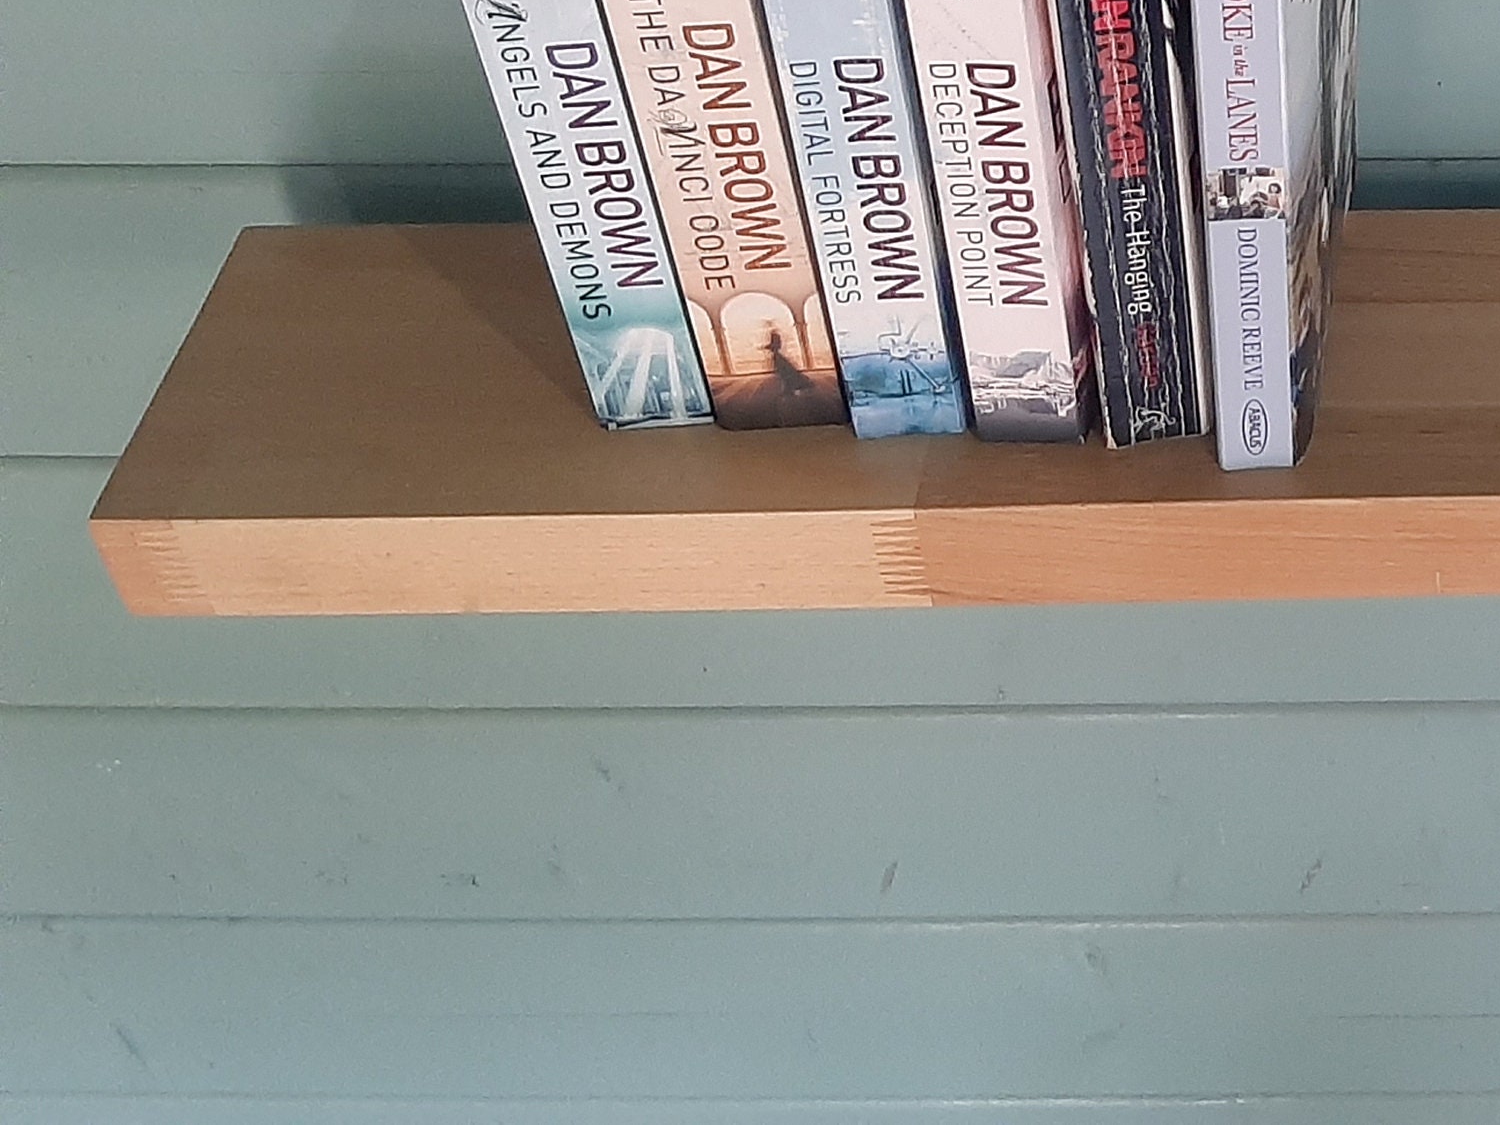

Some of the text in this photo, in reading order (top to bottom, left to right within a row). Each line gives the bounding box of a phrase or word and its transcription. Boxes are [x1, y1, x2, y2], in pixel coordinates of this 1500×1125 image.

[1095, 31, 1148, 180] RANKIN
[1225, 78, 1260, 164] LANES
[1232, 45, 1248, 56] in
[1234, 57, 1249, 77] the
[525, 129, 571, 190] AND
[549, 201, 612, 321] DEMONS
[545, 41, 664, 288] DAN BROWN
[648, 65, 686, 106] DA
[689, 215, 736, 291] CODE
[682, 23, 792, 271] DAN BROWN
[789, 61, 862, 304] DIGITAL FORTRESS
[833, 58, 924, 301] DAN BROWN
[929, 63, 993, 306] DECEPTION POINT
[965, 62, 1048, 307] DAN BROWN
[1121, 184, 1148, 224] The
[1124, 230, 1153, 315] Hanging
[1237, 228, 1264, 391] DOMINIC REEVE
[1249, 406, 1262, 449] ABACUS
